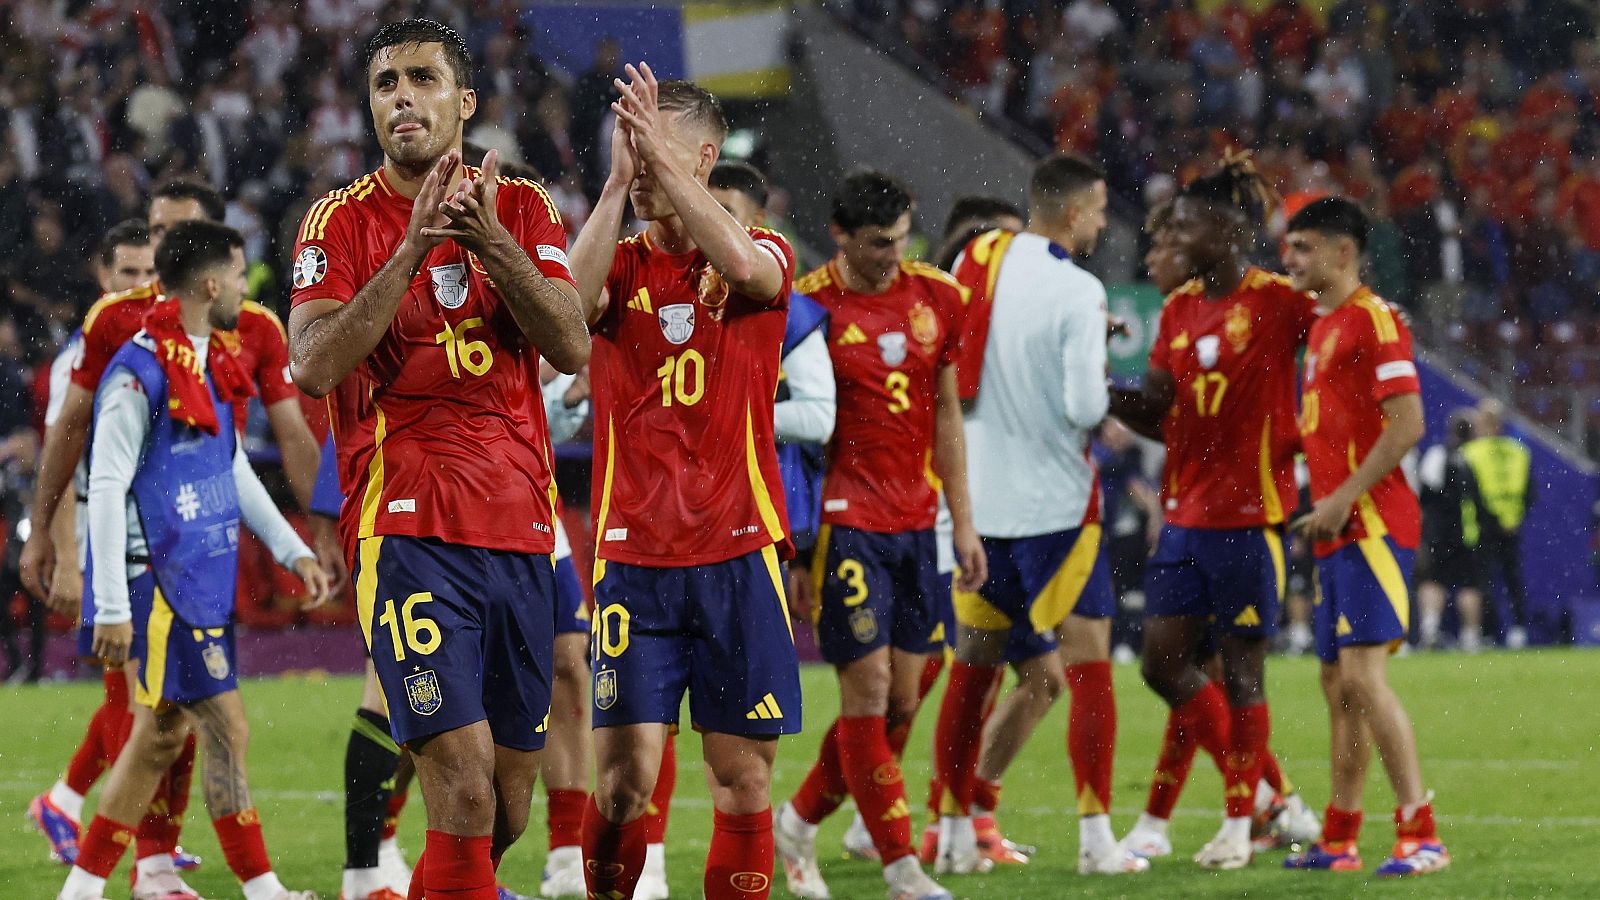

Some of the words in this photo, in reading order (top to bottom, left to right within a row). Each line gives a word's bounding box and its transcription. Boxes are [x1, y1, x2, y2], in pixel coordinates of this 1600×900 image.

[435, 316, 493, 379] 16
[656, 348, 705, 408] 10
[885, 370, 911, 414] 3
[1191, 371, 1229, 417] 17
[836, 558, 869, 608] 3
[379, 591, 442, 662] 16
[591, 602, 631, 662] 10
